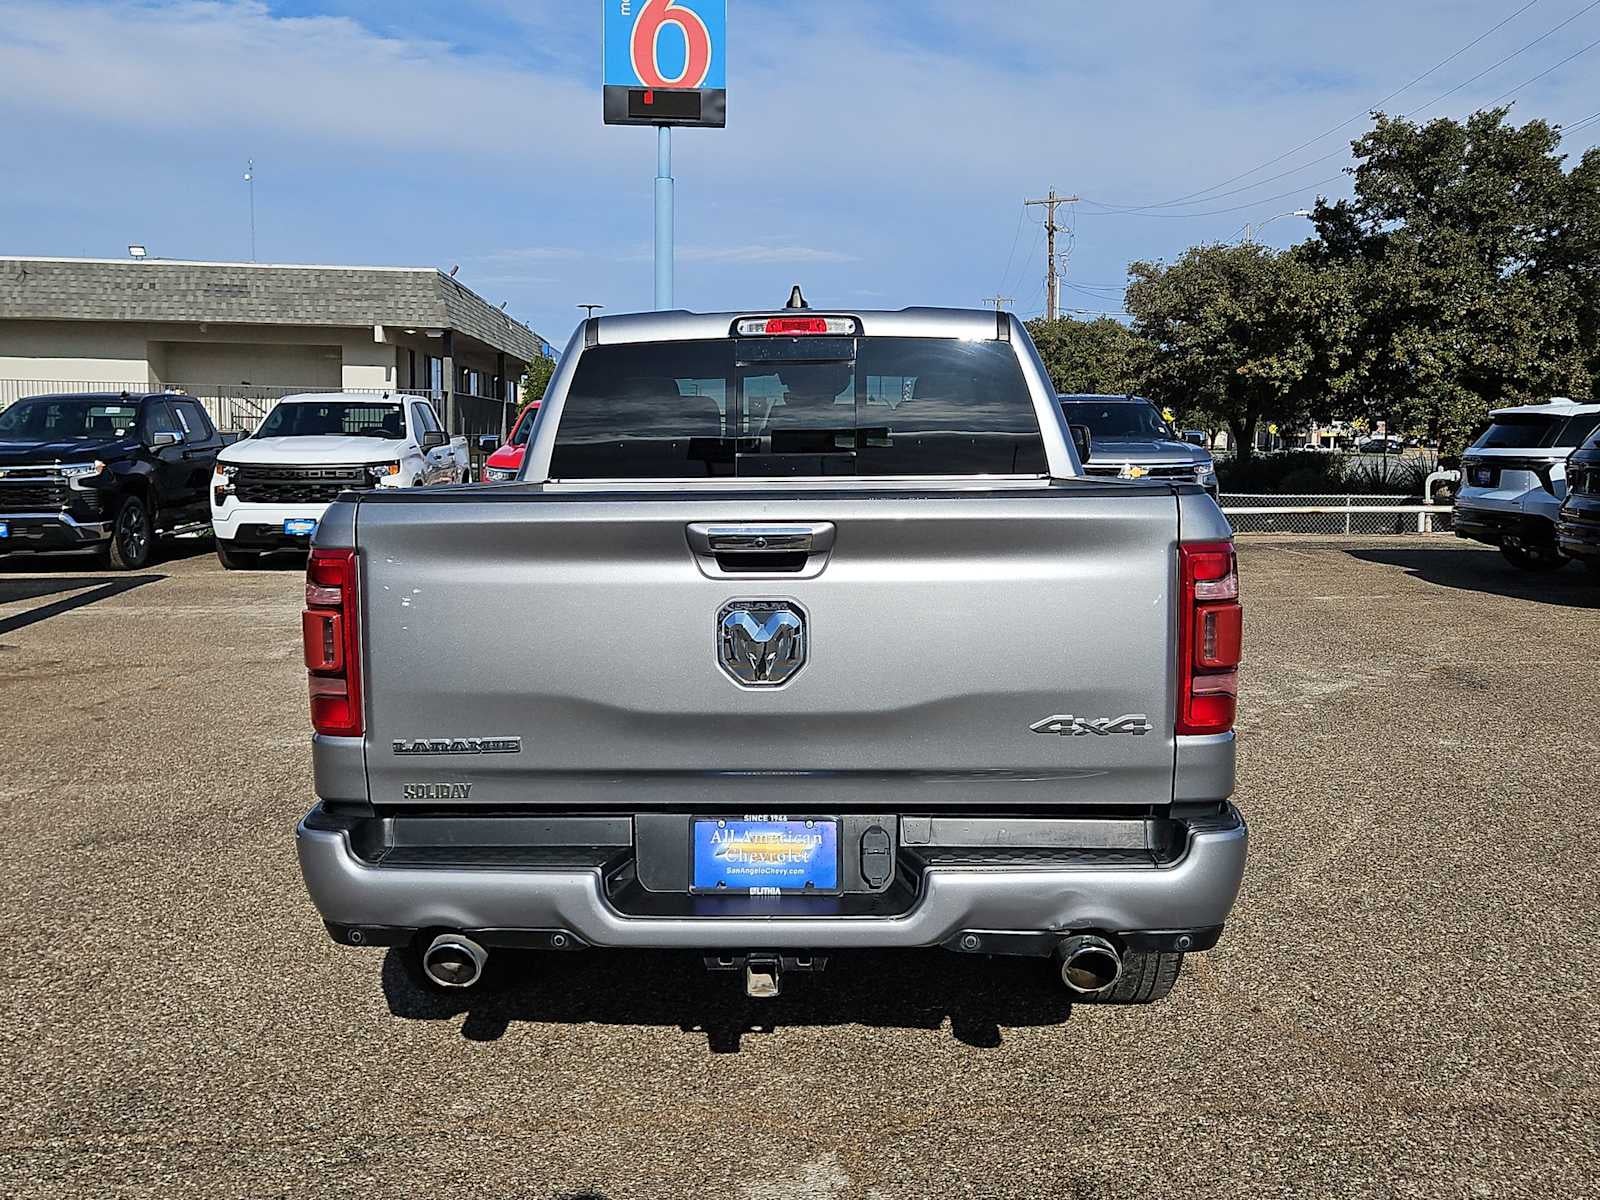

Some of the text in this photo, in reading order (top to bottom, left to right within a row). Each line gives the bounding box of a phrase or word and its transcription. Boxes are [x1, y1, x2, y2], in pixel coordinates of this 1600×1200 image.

[630, 0, 712, 88] 6
[743, 814, 769, 822] SINCE
[710, 830, 823, 845] All American
[726, 847, 810, 863] Chevrolet
[726, 867, 805, 876] SanAngeloChevy.com
